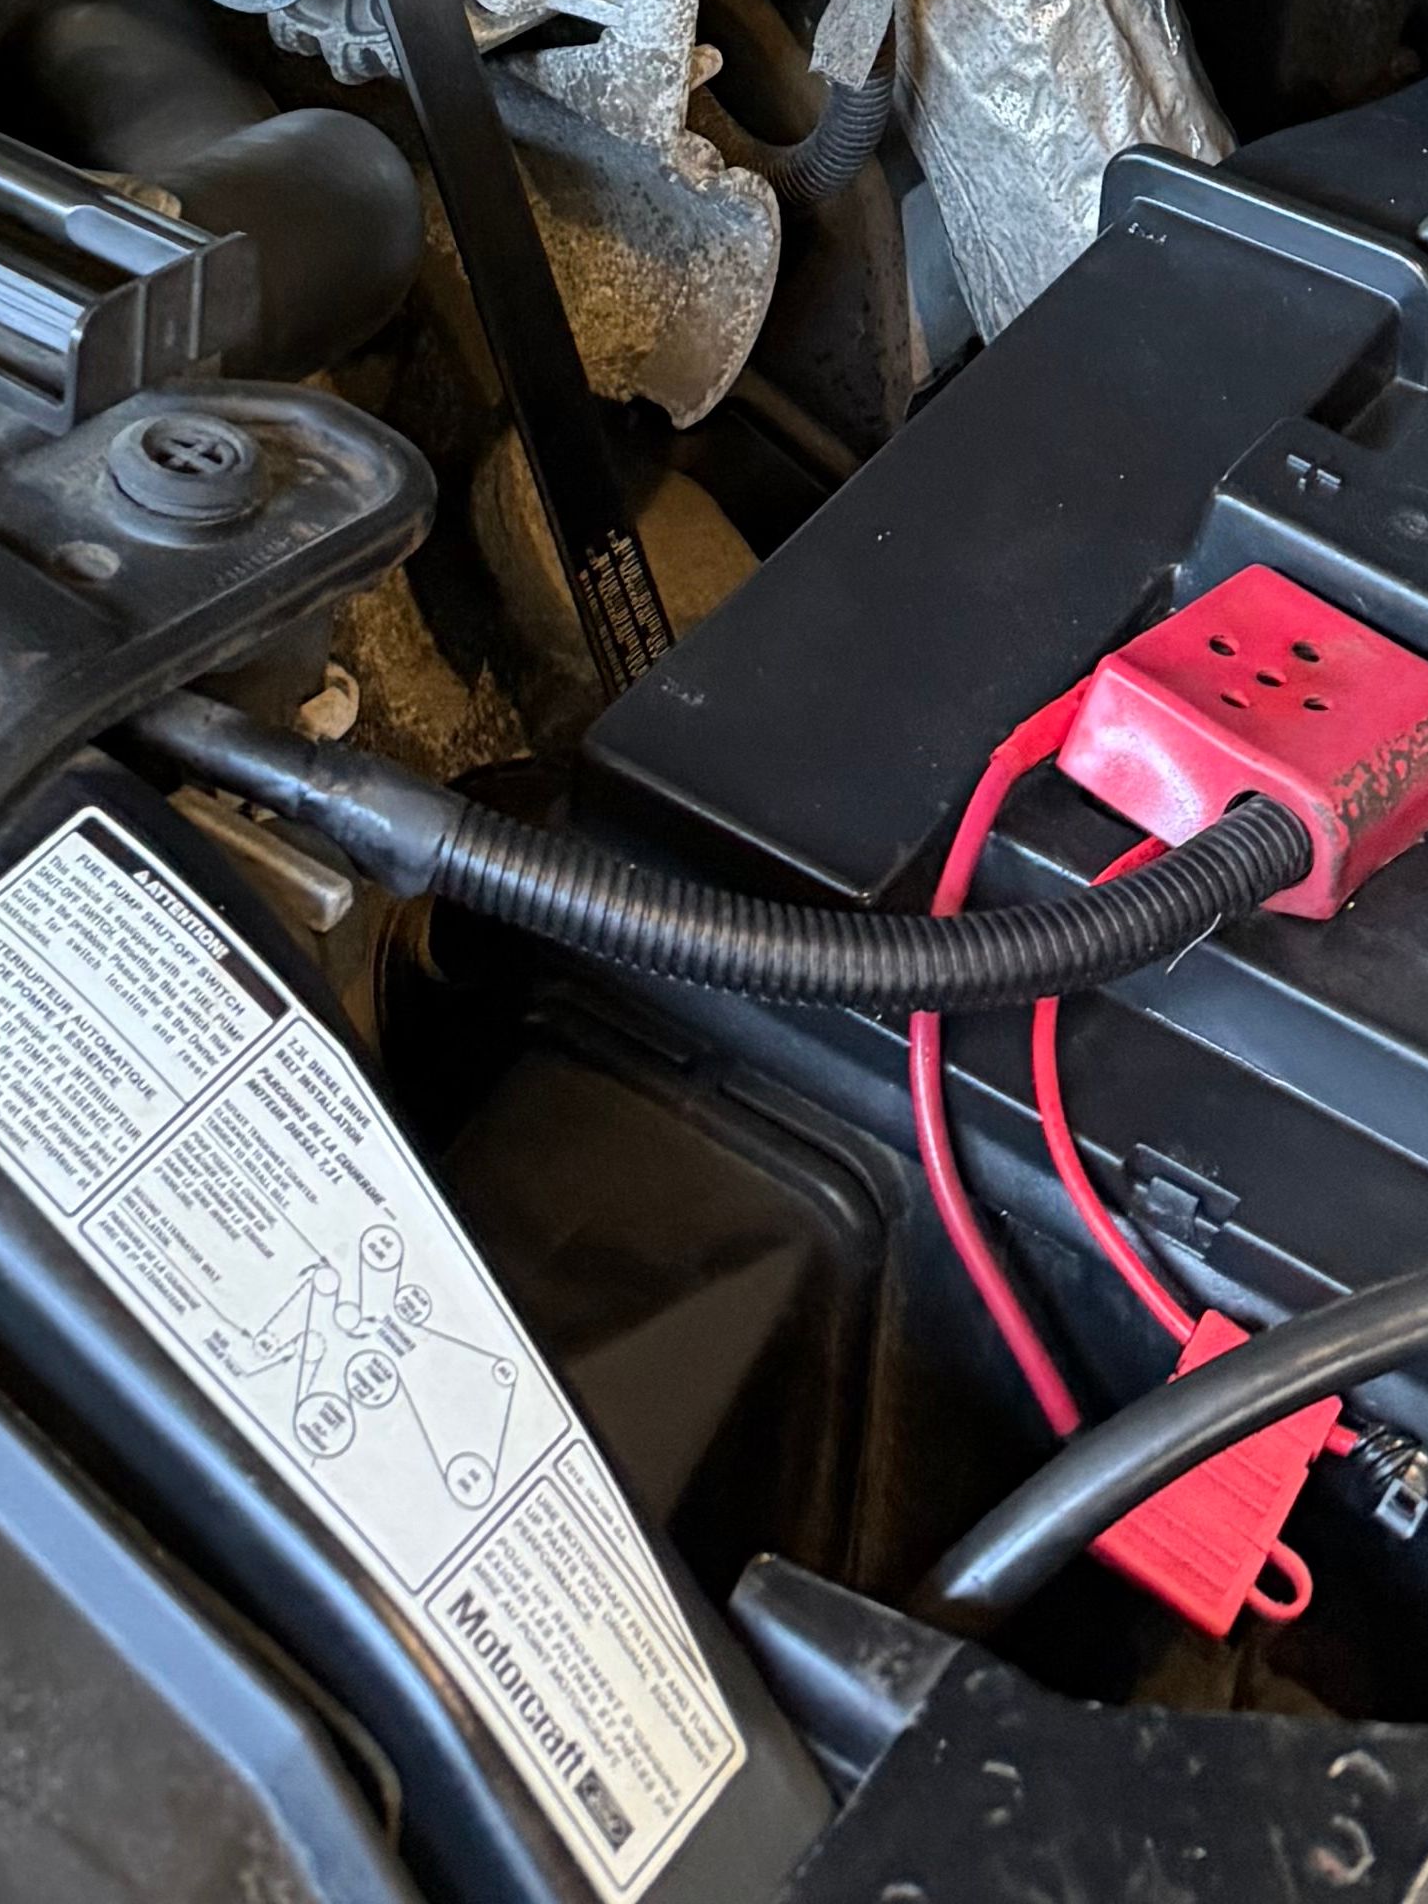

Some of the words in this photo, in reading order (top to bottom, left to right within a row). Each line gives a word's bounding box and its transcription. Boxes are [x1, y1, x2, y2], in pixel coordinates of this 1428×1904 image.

[22, 874, 58, 908] resolve
[54, 903, 74, 921] the
[108, 952, 142, 985] Please
[137, 982, 164, 1008] refer
[171, 1016, 192, 1036] the
[186, 1033, 221, 1067] Owner
[48, 854, 71, 876] This
[68, 872, 104, 906] vehicle
[110, 912, 158, 958] equipped
[155, 954, 182, 980] with
[186, 985, 217, 1014] FUEL
[212, 1012, 246, 1044] PUMP
[75, 852, 108, 883] FUEL
[105, 878, 143, 914] PUMP
[139, 910, 200, 968] SHUT-OFF
[194, 966, 247, 1017] SWITCH
[143, 877, 230, 960] ATTENTION!
[10, 886, 42, 917] Guide
[43, 916, 63, 934] for
[65, 935, 102, 971] switch
[104, 972, 150, 1017] location
[150, 1020, 176, 1045] and
[176, 1048, 209, 1080] reset
[10, 978, 57, 1022] POMPE
[62, 1029, 124, 1089] ESSENCE
[113, 936, 162, 982] Resetting
[157, 978, 181, 1000] this
[176, 997, 213, 1033] switch
[205, 1032, 233, 1058] may
[0, 1020, 18, 1038] DE
[14, 1035, 55, 1075] POMPE
[60, 1083, 117, 1139] ESSENCE.
[111, 1135, 131, 1154] Le
[8, 1078, 40, 1109] Guide
[11, 1009, 50, 1046] équipé
[46, 1042, 72, 1067] d'un
[69, 1065, 144, 1142] INTERRUPTEUR
[11, 1056, 34, 1078] cet
[29, 1075, 94, 1141] interrupteur
[88, 1138, 119, 1167] peut
[69, 1011, 158, 1101] AUTOMATIQUE
[255, 1065, 310, 1123] PARCOURS
[305, 1120, 325, 1140] DE
[319, 1135, 339, 1155] LA
[273, 1048, 301, 1077] BELT
[295, 1073, 364, 1146] INSTALLATION
[306, 1059, 341, 1096] DIESEL
[338, 1094, 372, 1129] DRIVE
[0, 1097, 22, 1118] cet
[16, 1115, 80, 1178] interrupteur
[243, 1077, 288, 1125] MOTEUR
[283, 1119, 321, 1160] DIESEL
[541, 1528, 579, 1576] PARTS
[442, 1586, 593, 1782] Motorcraft
